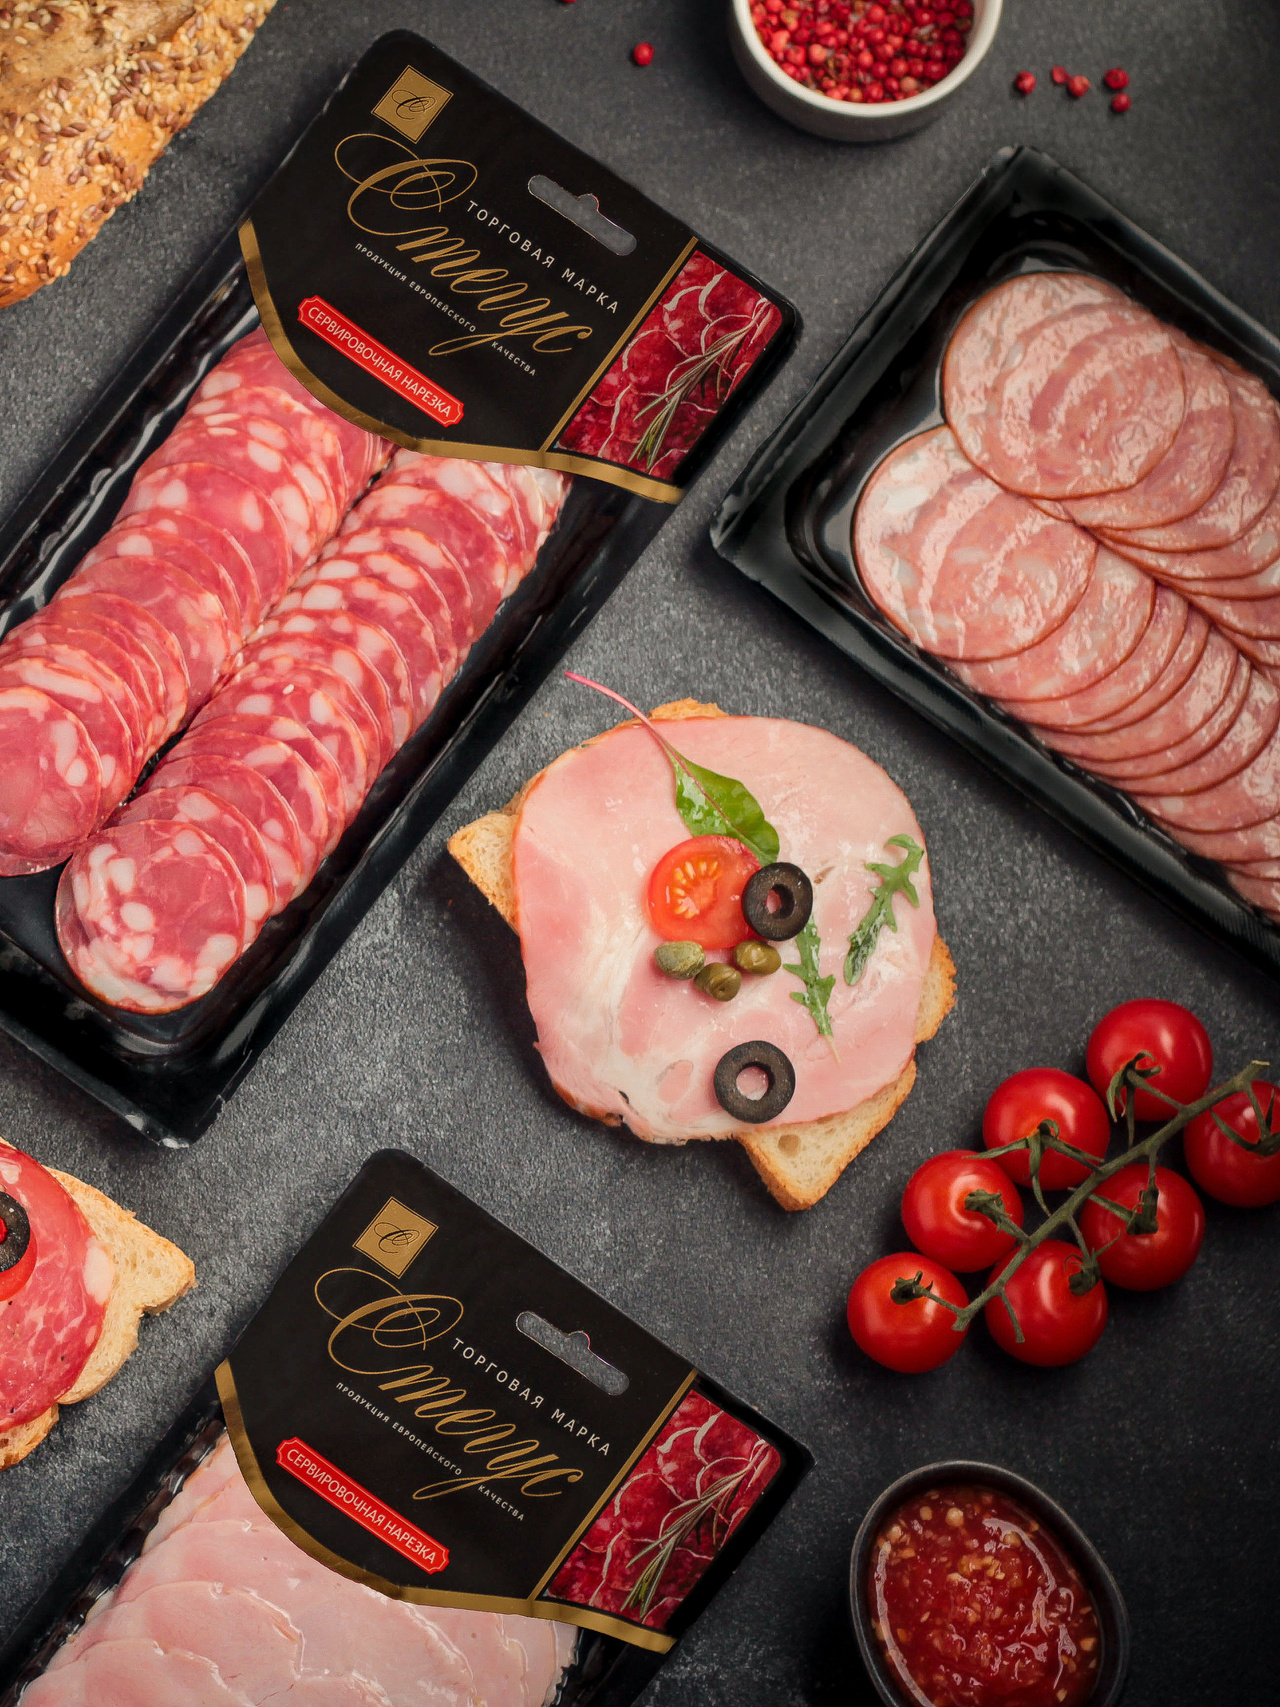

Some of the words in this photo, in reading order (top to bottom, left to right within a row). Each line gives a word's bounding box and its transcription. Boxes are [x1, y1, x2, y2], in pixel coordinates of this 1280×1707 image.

[355, 243, 408, 283] ПРОДУКЦИЯ
[409, 280, 476, 333] ЕВРОПЕЙСКОГО
[492, 341, 537, 376] КАЧЕСТВА
[467, 200, 554, 268] ТОРГОВАЯ
[562, 268, 618, 314] МАРКА
[307, 307, 403, 382] СЕРВИРОВОЧНАЯ
[401, 375, 452, 418] НАРЕЗКА
[336, 1382, 390, 1423] ПРОДУКЦИЯ
[392, 1421, 462, 1476] ЕВРОПЕЙСКОГО
[478, 1485, 524, 1521] КАЧЕСТВА
[454, 1338, 544, 1408] ТОРГОВАЯ
[552, 1409, 611, 1456] МАРКА
[286, 1448, 386, 1526] СЕРВИРОВОЧНАЯ
[383, 1519, 436, 1564] НАРЕЗКА
